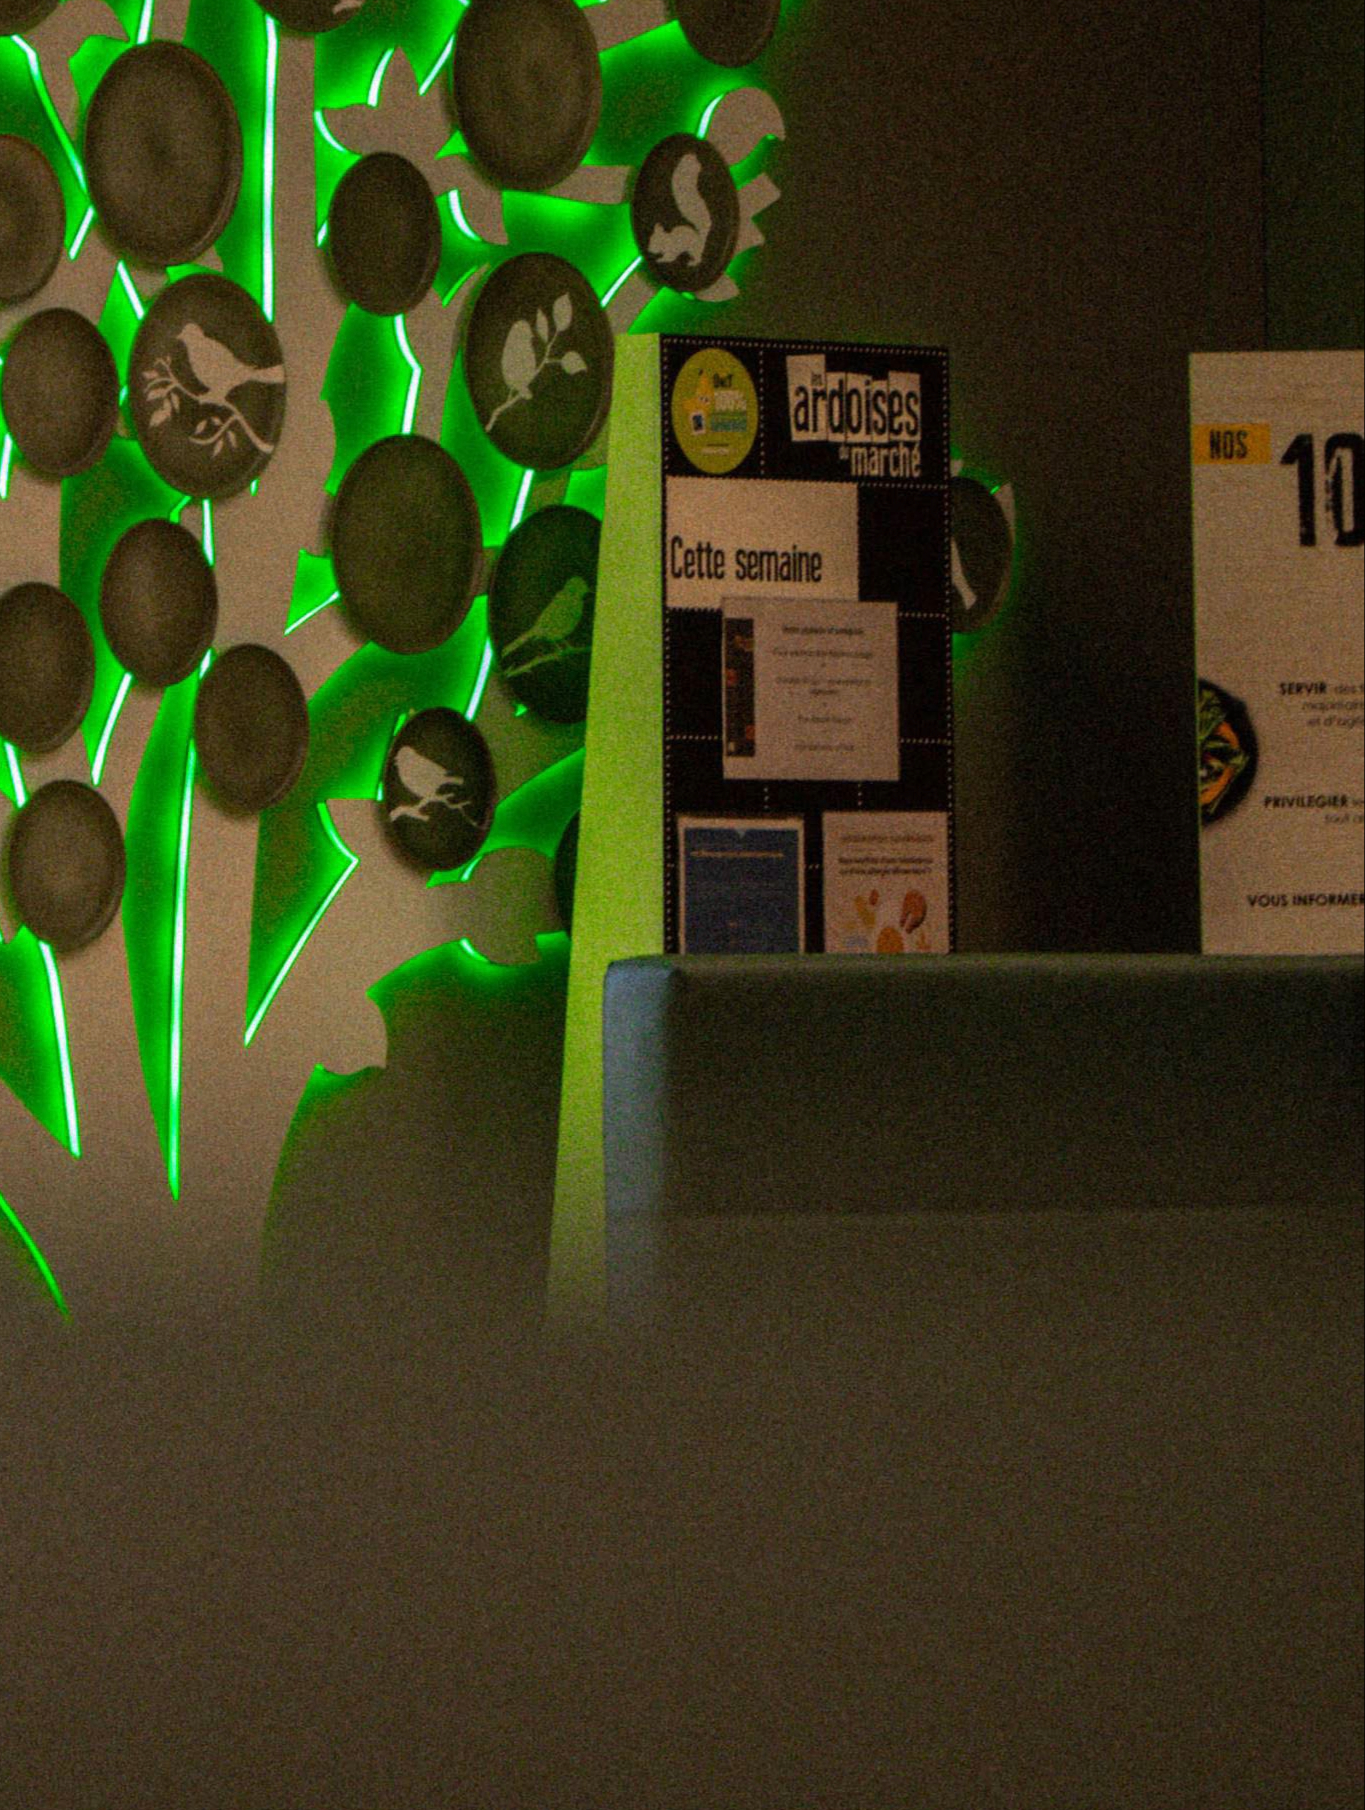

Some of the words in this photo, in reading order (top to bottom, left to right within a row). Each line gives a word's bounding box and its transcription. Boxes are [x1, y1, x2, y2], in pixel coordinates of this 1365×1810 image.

[793, 377, 920, 437] ardoises
[850, 441, 921, 479] marché
[1209, 429, 1248, 460] NOS
[1280, 432, 1364, 547] 10
[670, 535, 725, 579] Cette
[736, 544, 823, 583] semaine
[1279, 681, 1327, 695] SERVIR
[1246, 893, 1288, 908] VOUS
